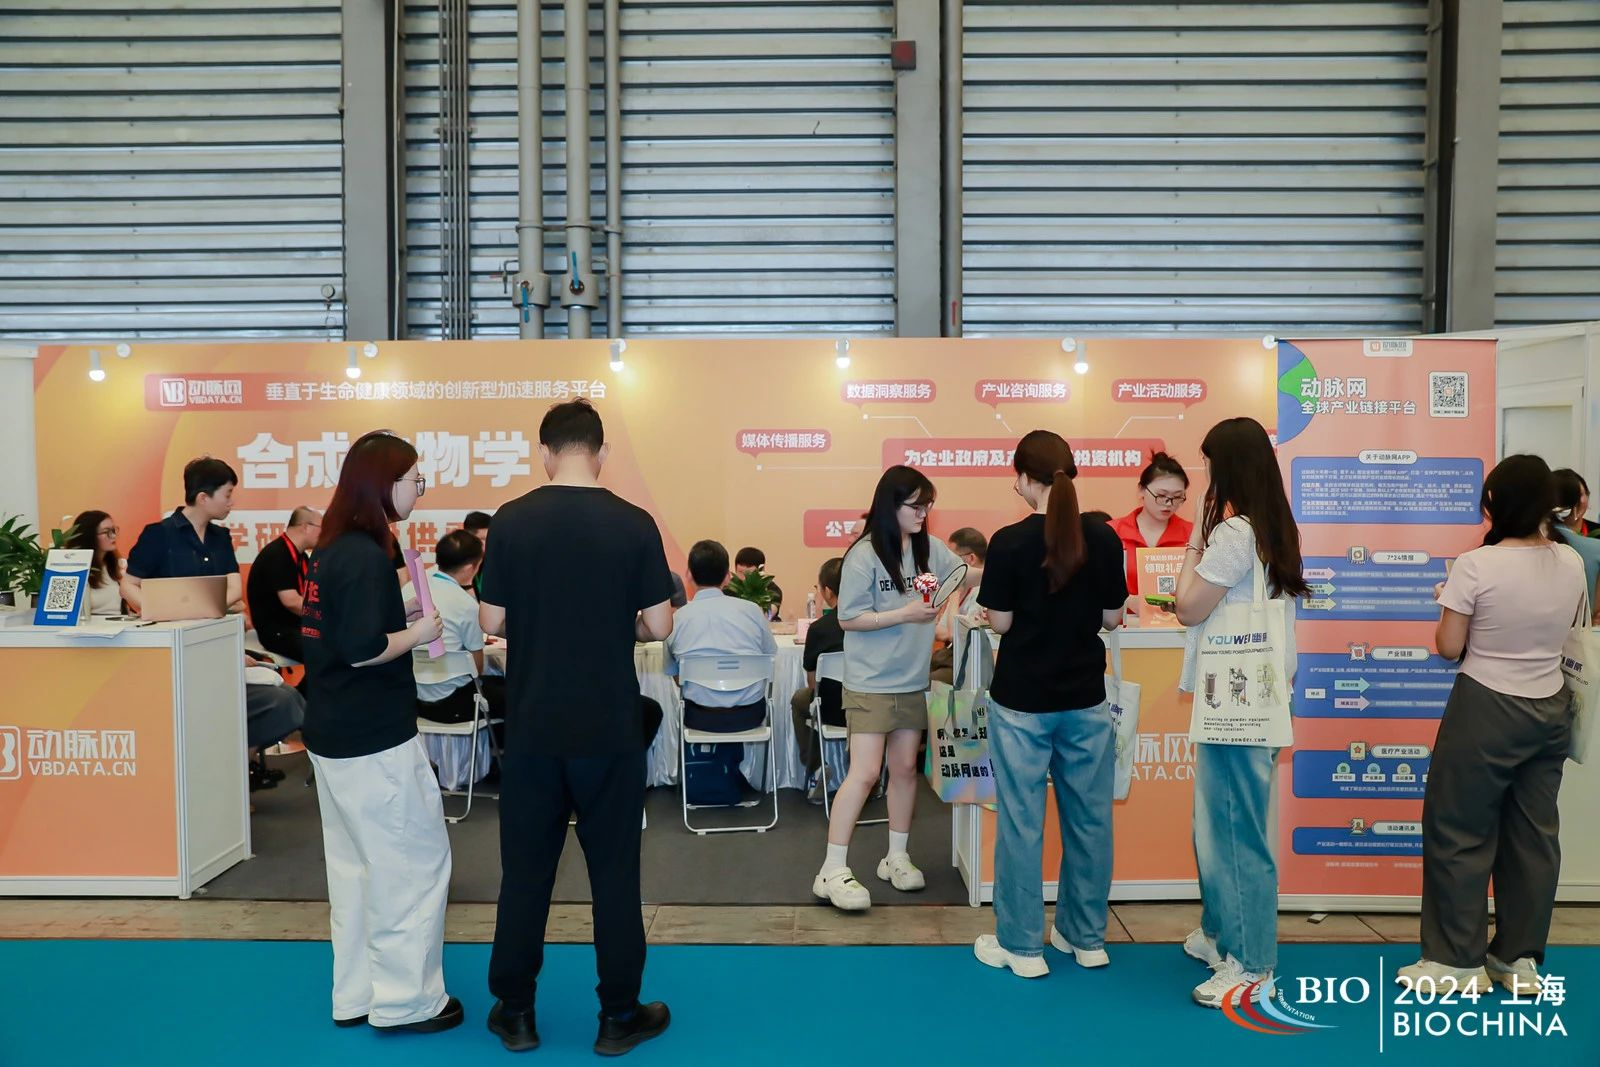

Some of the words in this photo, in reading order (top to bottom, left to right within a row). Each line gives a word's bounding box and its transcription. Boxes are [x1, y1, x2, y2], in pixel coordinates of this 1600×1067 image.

[188, 380, 242, 396] 动脉网
[266, 380, 607, 401] 垂直于生命健康领域的创新型加速服务平台
[847, 384, 932, 399] 数据洞察服务
[982, 383, 1067, 399] 产业咨询服务
[1118, 383, 1202, 399] 产业活动服务
[1301, 378, 1367, 398] 动脉网
[1301, 401, 1417, 415] 全球产业链接平台
[742, 433, 827, 449] 媒体传播服务
[237, 431, 531, 489] 合成物学
[1366, 453, 1411, 461] 关于动脉网APP
[1208, 633, 1251, 645] YOUWEI
[27, 729, 136, 759] 动脉网
[1381, 747, 1420, 755] 医疗产业活动
[28, 761, 137, 776] VBDATA.CN
